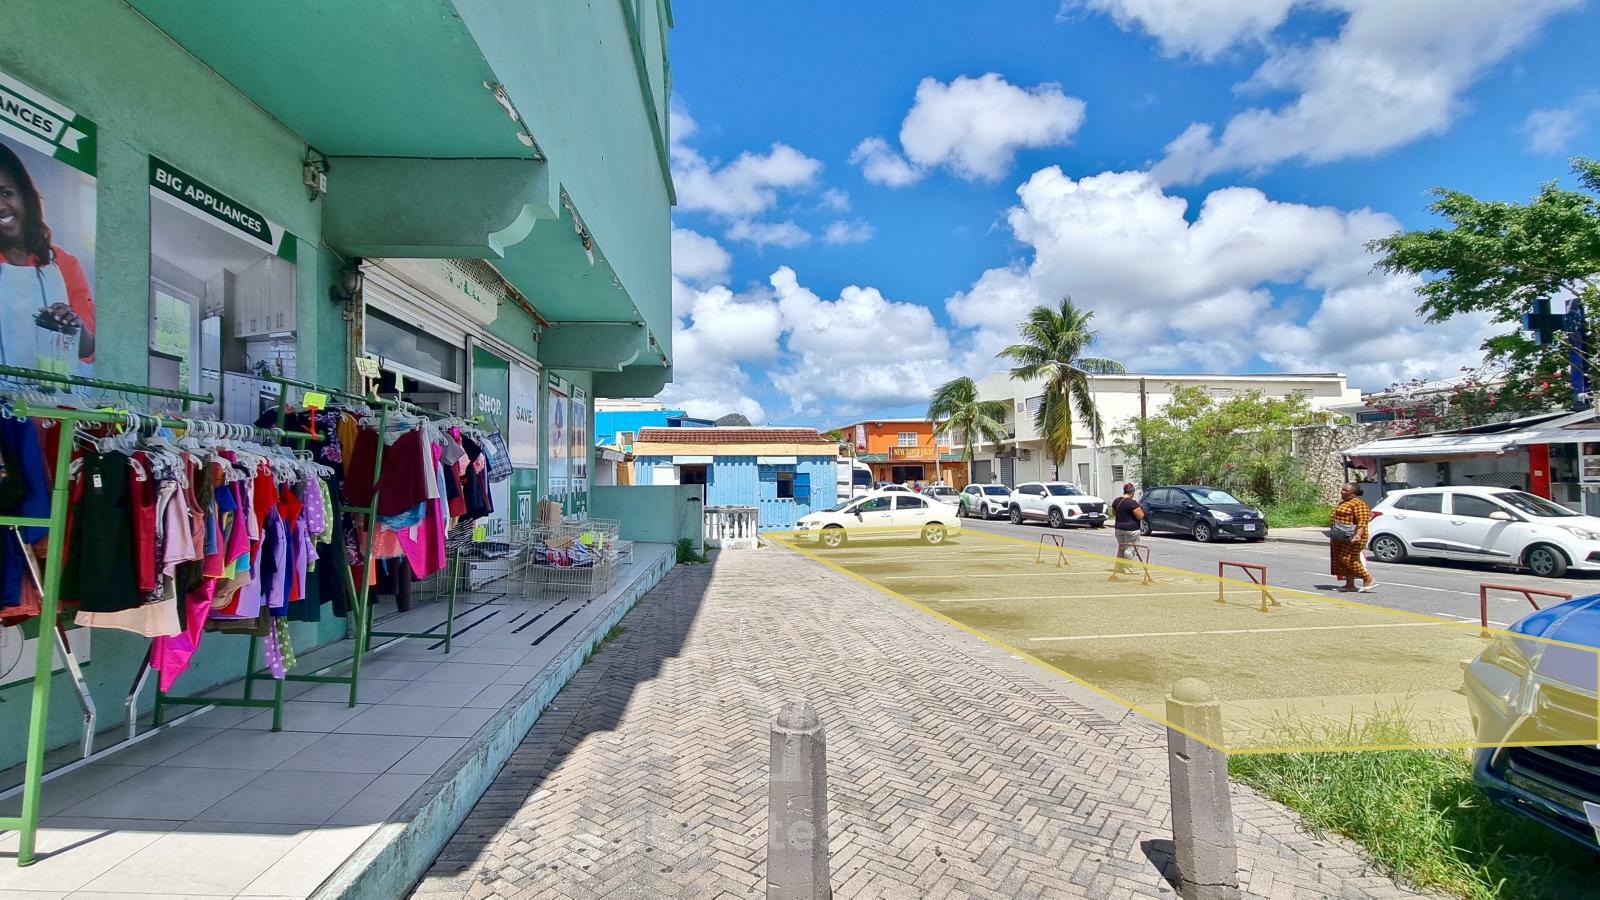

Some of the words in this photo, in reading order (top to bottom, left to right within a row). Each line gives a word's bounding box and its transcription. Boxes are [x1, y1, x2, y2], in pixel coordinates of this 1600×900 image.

[155, 167, 183, 192] BIG
[184, 184, 262, 233] APPLIANCES
[478, 393, 502, 416] SHOP.
[516, 406, 534, 425] SAVE.
